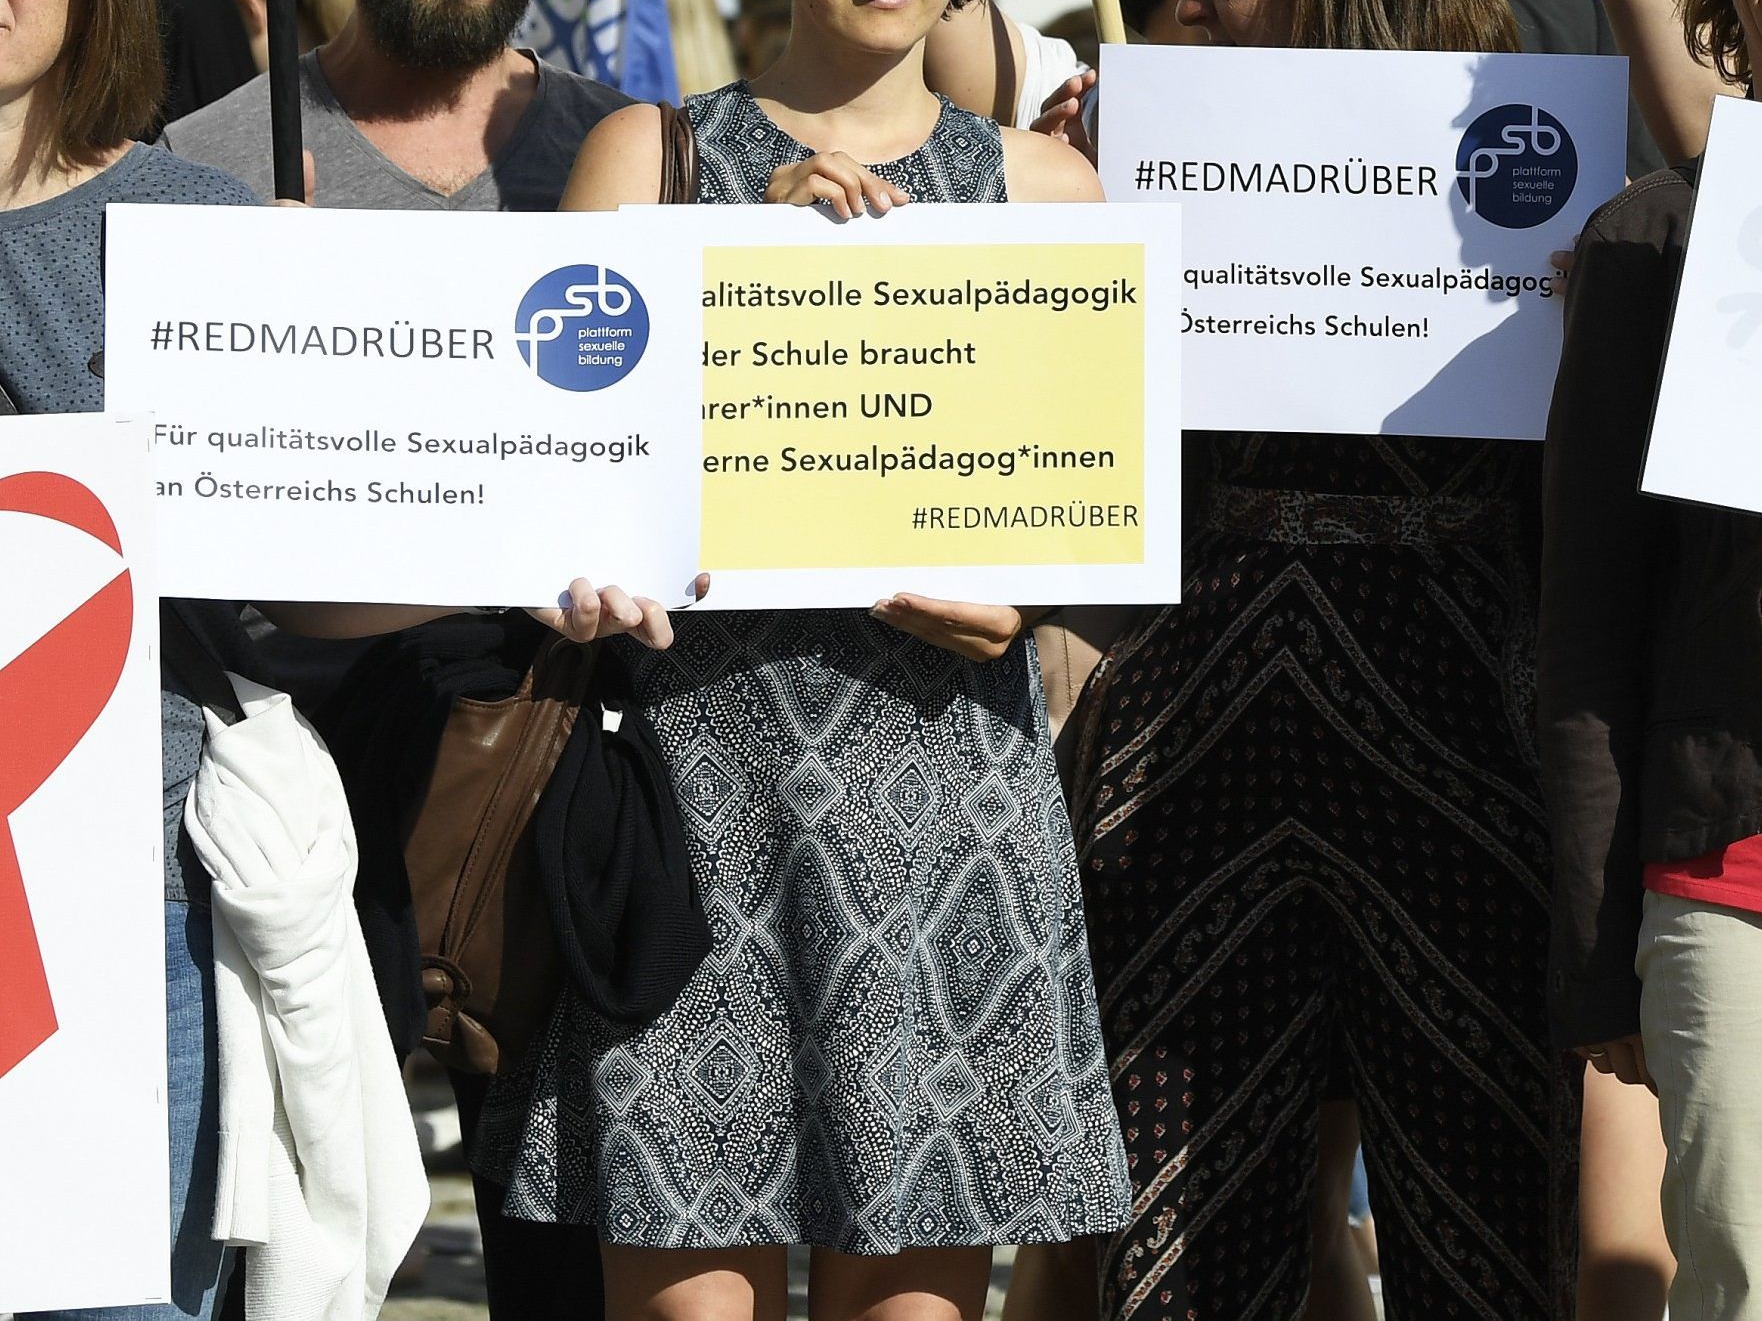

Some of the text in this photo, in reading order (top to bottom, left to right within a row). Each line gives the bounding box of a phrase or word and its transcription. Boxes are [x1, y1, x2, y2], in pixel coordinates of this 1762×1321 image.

[1134, 157, 1438, 197] #REDMADRÜBER
[1512, 166, 1562, 178] plattform
[1512, 180, 1555, 190] sexuelle
[1512, 193, 1552, 205] bildung
[1183, 262, 1568, 298] qualitätsvolle Sexualpädagog
[873, 278, 1138, 312] Sexualpädagogik
[150, 320, 495, 360] #REDMADRÜBER
[578, 327, 633, 339] plattform
[1325, 315, 1429, 339] Schulen!
[578, 341, 626, 352] sexuelle
[752, 340, 848, 367] Schule
[860, 339, 977, 365] braucht
[578, 354, 623, 367] bildung
[860, 392, 933, 419] UND
[155, 423, 650, 464] Für qualitätsvolle Sexualpädagogik
[703, 454, 769, 474] erne
[156, 471, 485, 506] an Österreichs Schulen!
[912, 501, 1139, 530] #REDMADRÜBER
